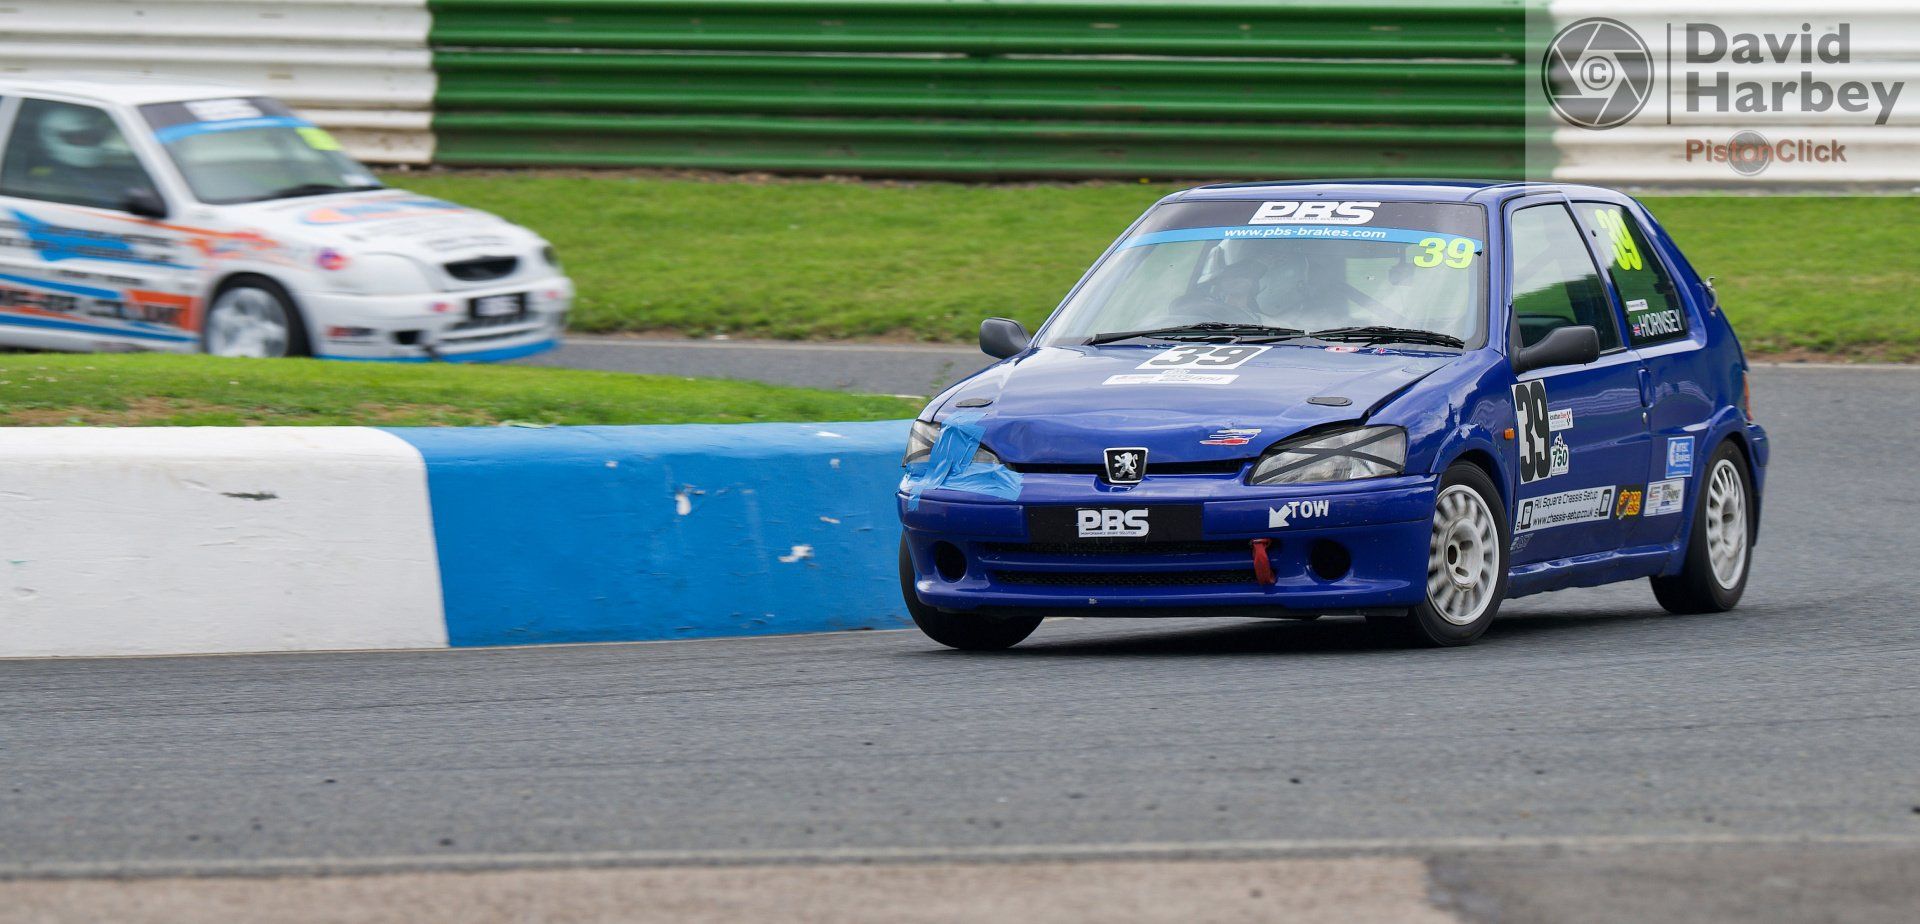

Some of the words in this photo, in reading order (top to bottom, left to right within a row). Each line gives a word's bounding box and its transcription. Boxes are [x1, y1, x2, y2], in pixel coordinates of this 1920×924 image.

[1248, 201, 1381, 225] PBS
[1224, 227, 1387, 239] www.pbs-brakes.com
[1594, 209, 1643, 270] 39
[1413, 237, 1475, 268] 39
[1637, 309, 1683, 337] HORNSEY
[1149, 346, 1263, 366] 39
[1515, 381, 1551, 482] 39
[1552, 449, 1568, 468] 750
[1288, 500, 1330, 518] TOW
[1543, 495, 1562, 509] Square
[1562, 492, 1583, 504] Chassis
[1078, 509, 1150, 538] PBS
